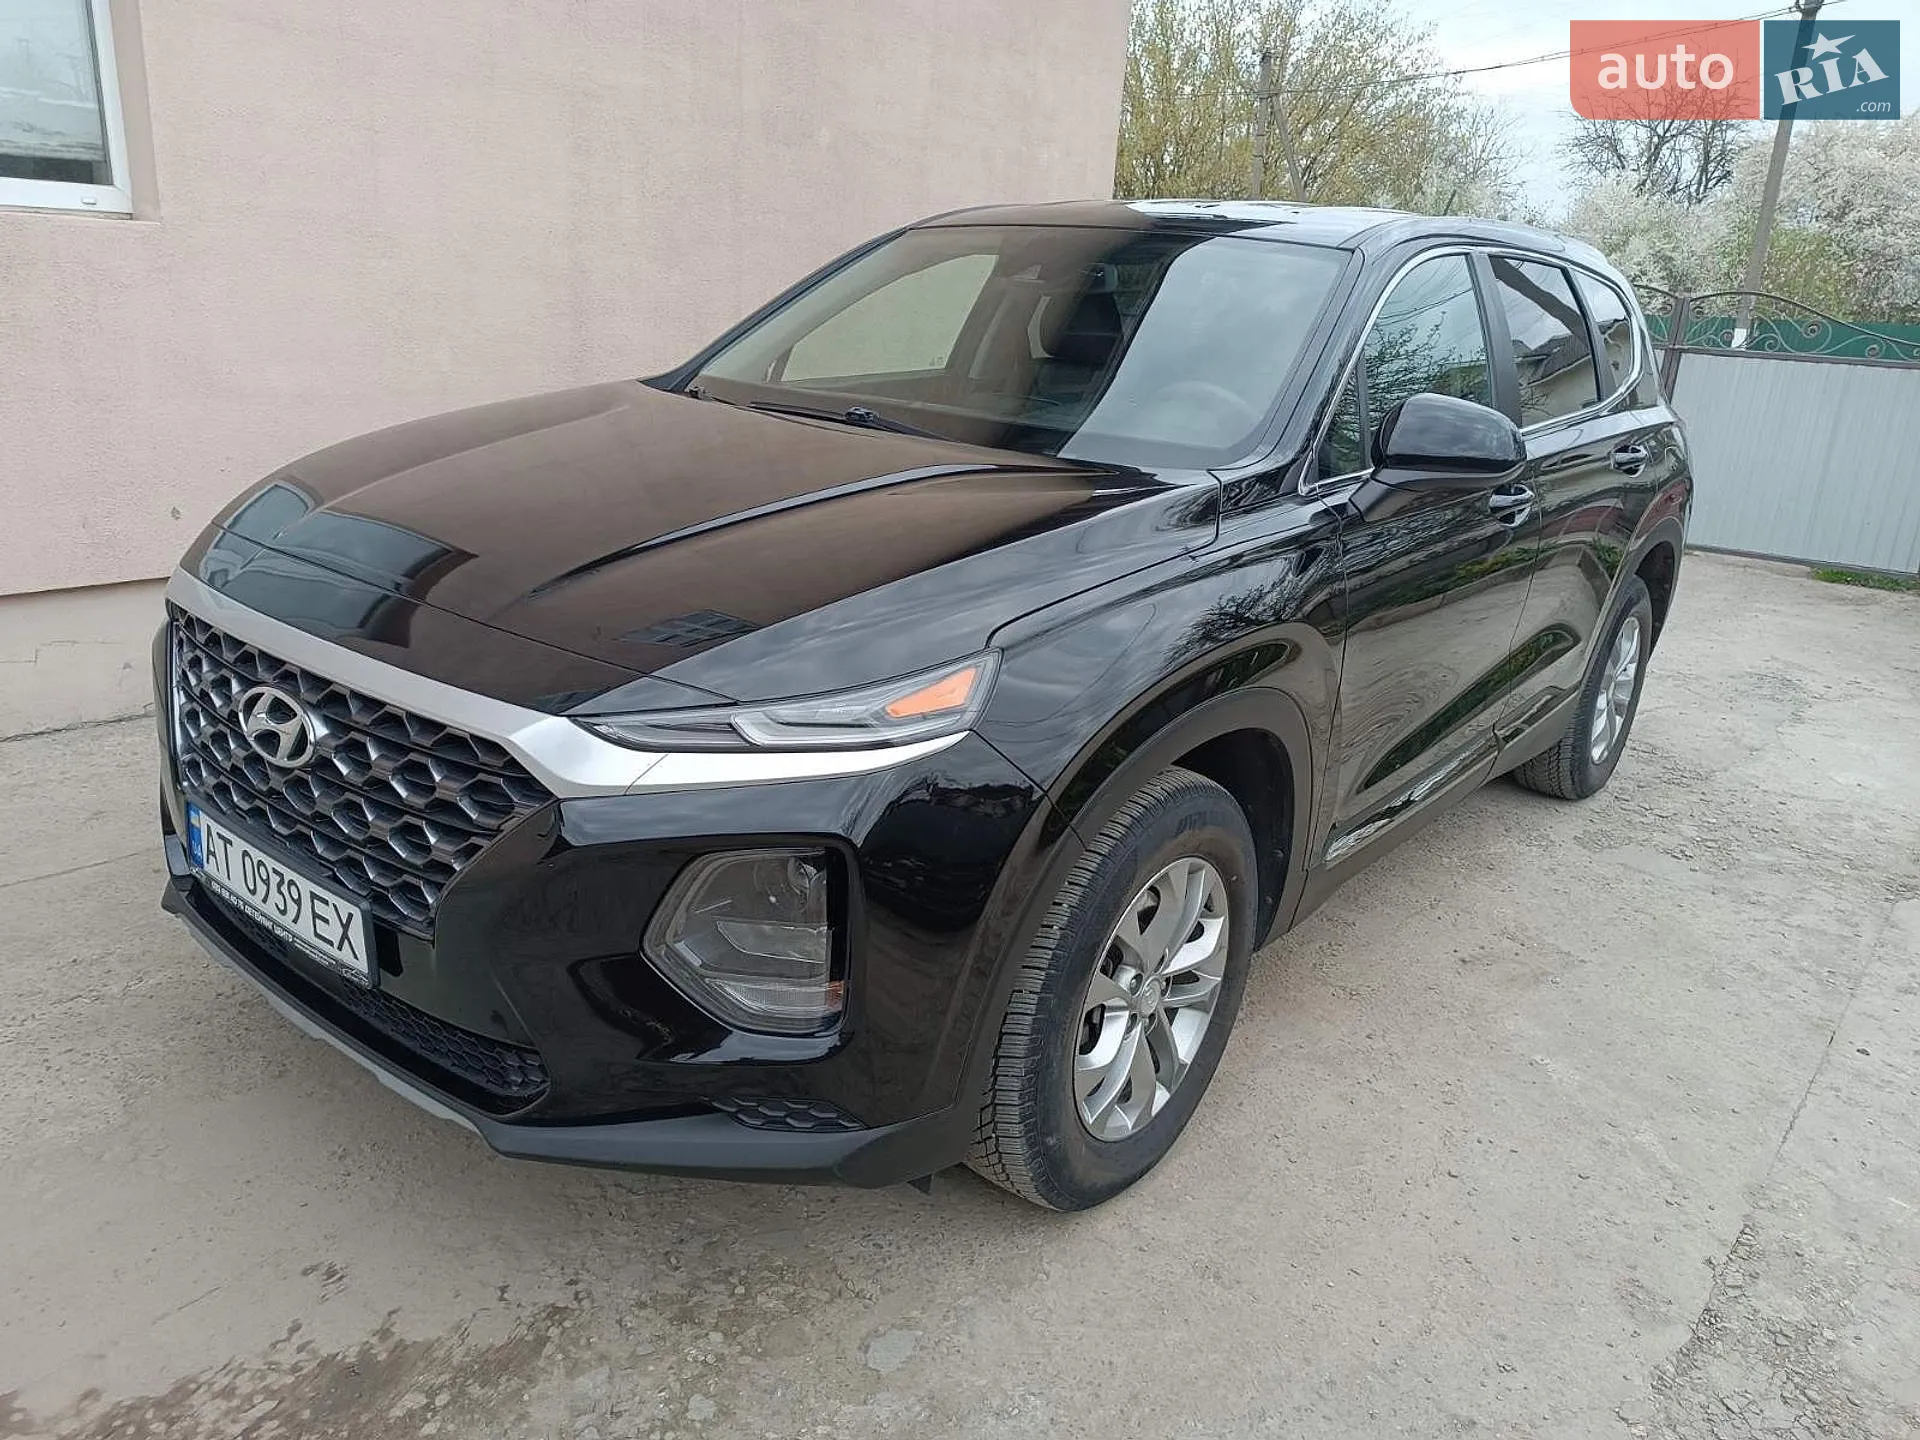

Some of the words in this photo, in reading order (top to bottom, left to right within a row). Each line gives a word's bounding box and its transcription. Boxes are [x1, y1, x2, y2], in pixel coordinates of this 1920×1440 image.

[206, 823, 233, 881] AT
[242, 849, 303, 925] 0939
[310, 890, 360, 961] EX
